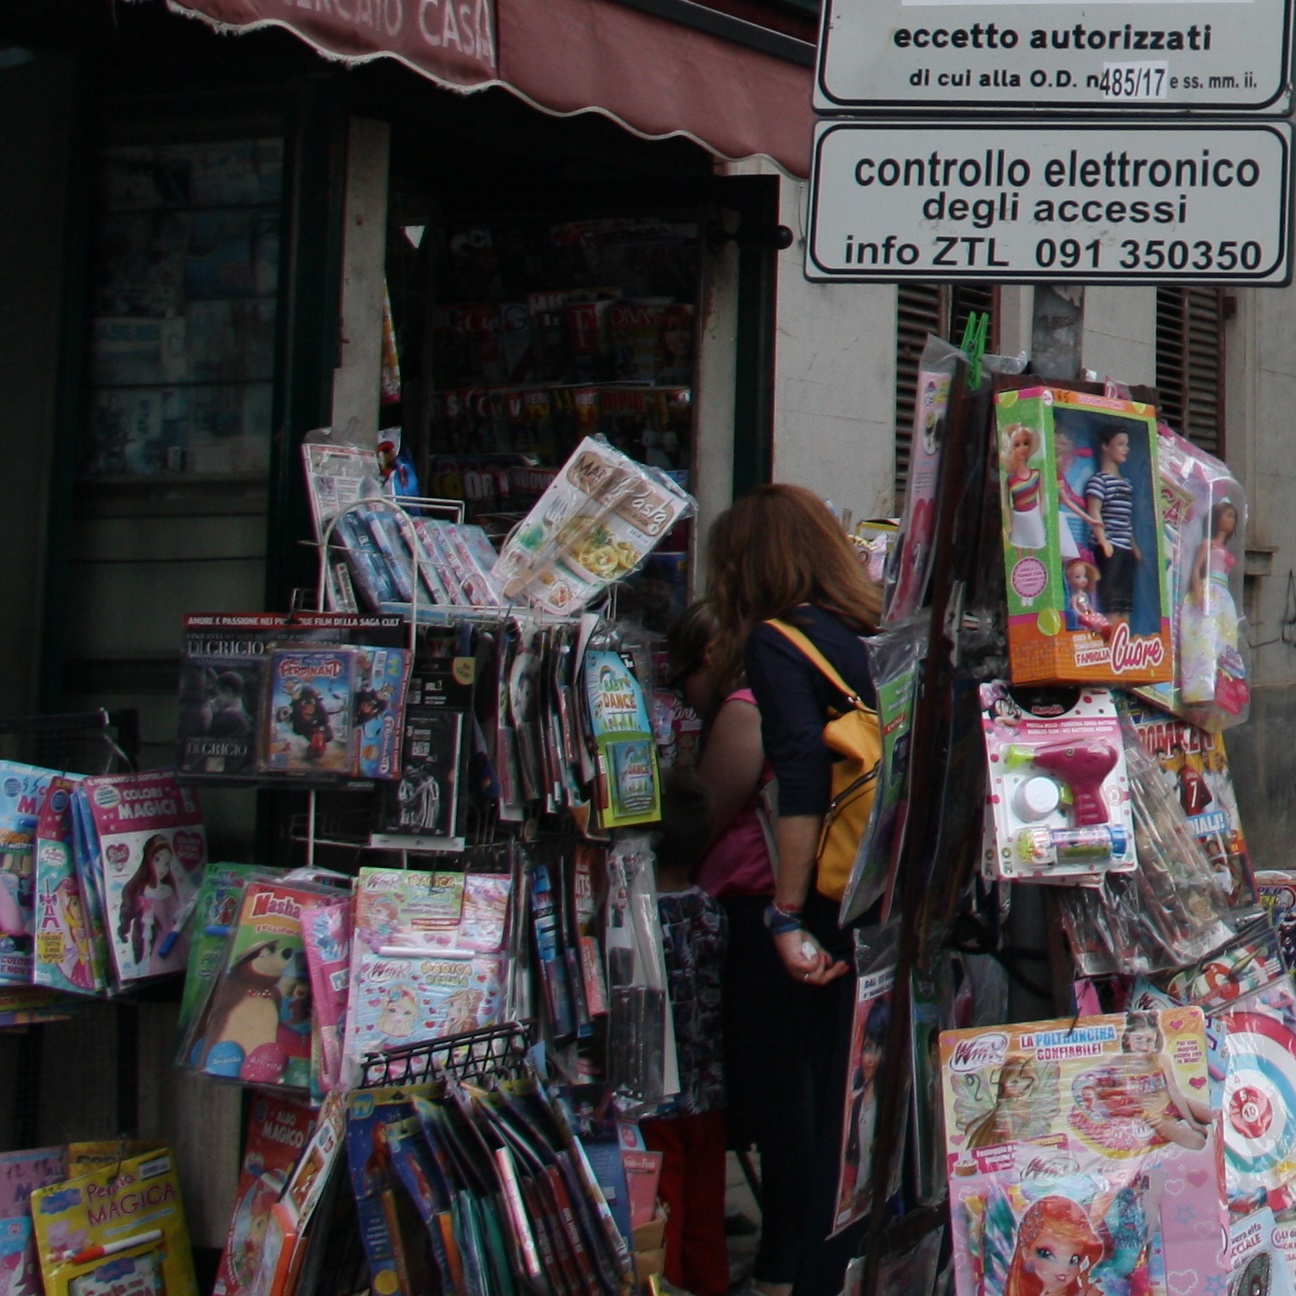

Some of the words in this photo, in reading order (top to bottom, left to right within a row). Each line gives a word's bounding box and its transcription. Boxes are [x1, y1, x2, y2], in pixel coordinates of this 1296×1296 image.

[893, 23, 1019, 50] eccetto
[1030, 24, 1213, 51] autorizzati
[909, 68, 931, 87] di
[937, 69, 972, 87] cui
[979, 69, 1021, 88] alla
[1030, 69, 1078, 88] O.D.
[1169, 78, 1179, 90] e
[1183, 78, 1204, 91] ss.
[1208, 78, 1239, 91] mm.
[1243, 73, 1258, 90] ii.
[854, 149, 1031, 188] controllo
[1043, 150, 1261, 188] elettronico
[923, 192, 1019, 229] degli
[1034, 194, 1188, 224] accessi
[844, 236, 921, 267] info
[932, 237, 1010, 267] ZTL
[1035, 239, 1102, 269] 091
[1119, 239, 1263, 271] 350350
[1019, 1035, 1035, 1050] LA
[87, 1182, 177, 1227] MAGICA
